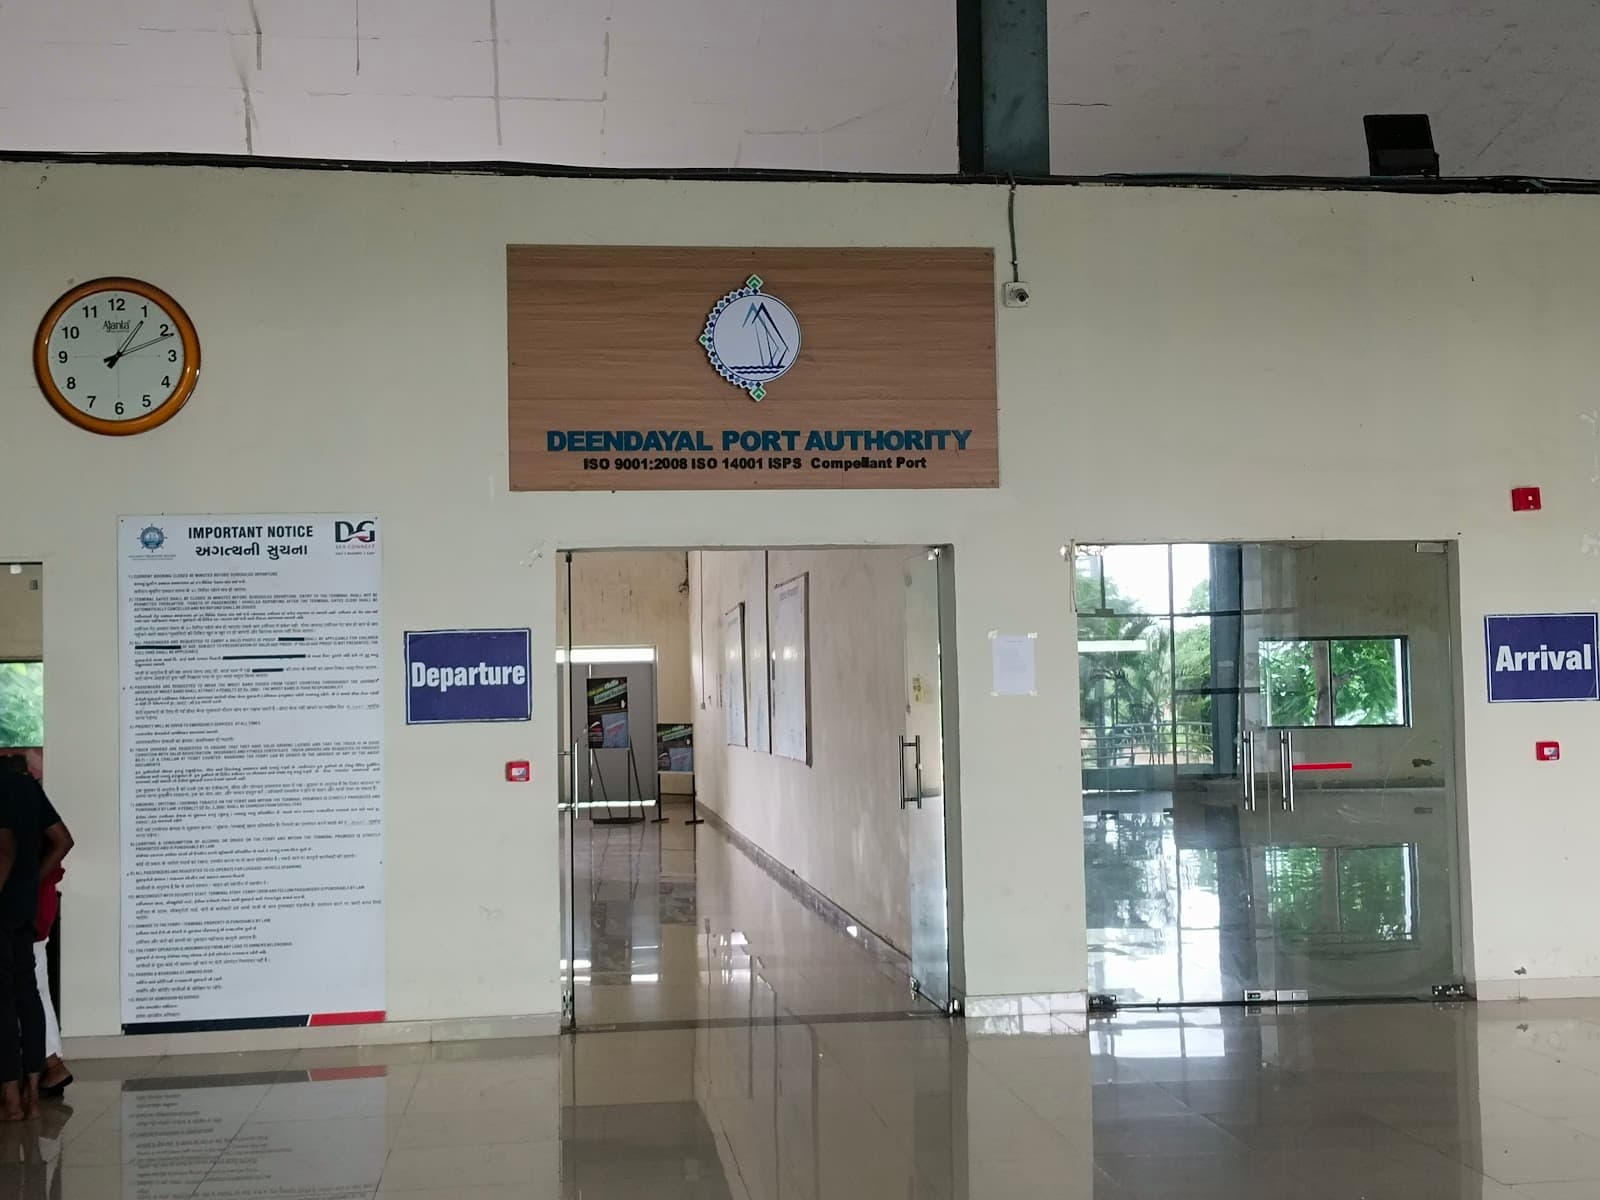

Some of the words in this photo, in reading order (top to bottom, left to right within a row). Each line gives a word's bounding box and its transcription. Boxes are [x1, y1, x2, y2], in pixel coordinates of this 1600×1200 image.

[108, 298, 126, 311] 12
[82, 306, 98, 318] 11
[141, 305, 149, 318] 1
[62, 326, 80, 339] 10
[160, 324, 170, 337] 2
[58, 351, 68, 364] 9
[168, 350, 177, 362] 3
[66, 377, 76, 389] 8
[161, 376, 171, 388] 4
[87, 396, 97, 408] 7
[142, 395, 151, 407] 5
[114, 402, 124, 415] 6
[547, 431, 713, 452] DEENDAYAL
[722, 431, 800, 451] PORT
[804, 430, 973, 451] AUTHORITY
[584, 458, 610, 470] ISO
[615, 457, 688, 470] 9001:2008
[691, 457, 718, 470] ISO
[722, 457, 764, 470] 14001
[768, 457, 802, 470] ISPS
[897, 456, 927, 469] Port
[188, 526, 263, 540] IMPORTANT
[267, 526, 314, 538] NOTICE
[195, 541, 260, 557] અગત્યની
[267, 543, 308, 560] સુચના
[1495, 644, 1592, 672] Arrival
[411, 661, 526, 692] Departure
